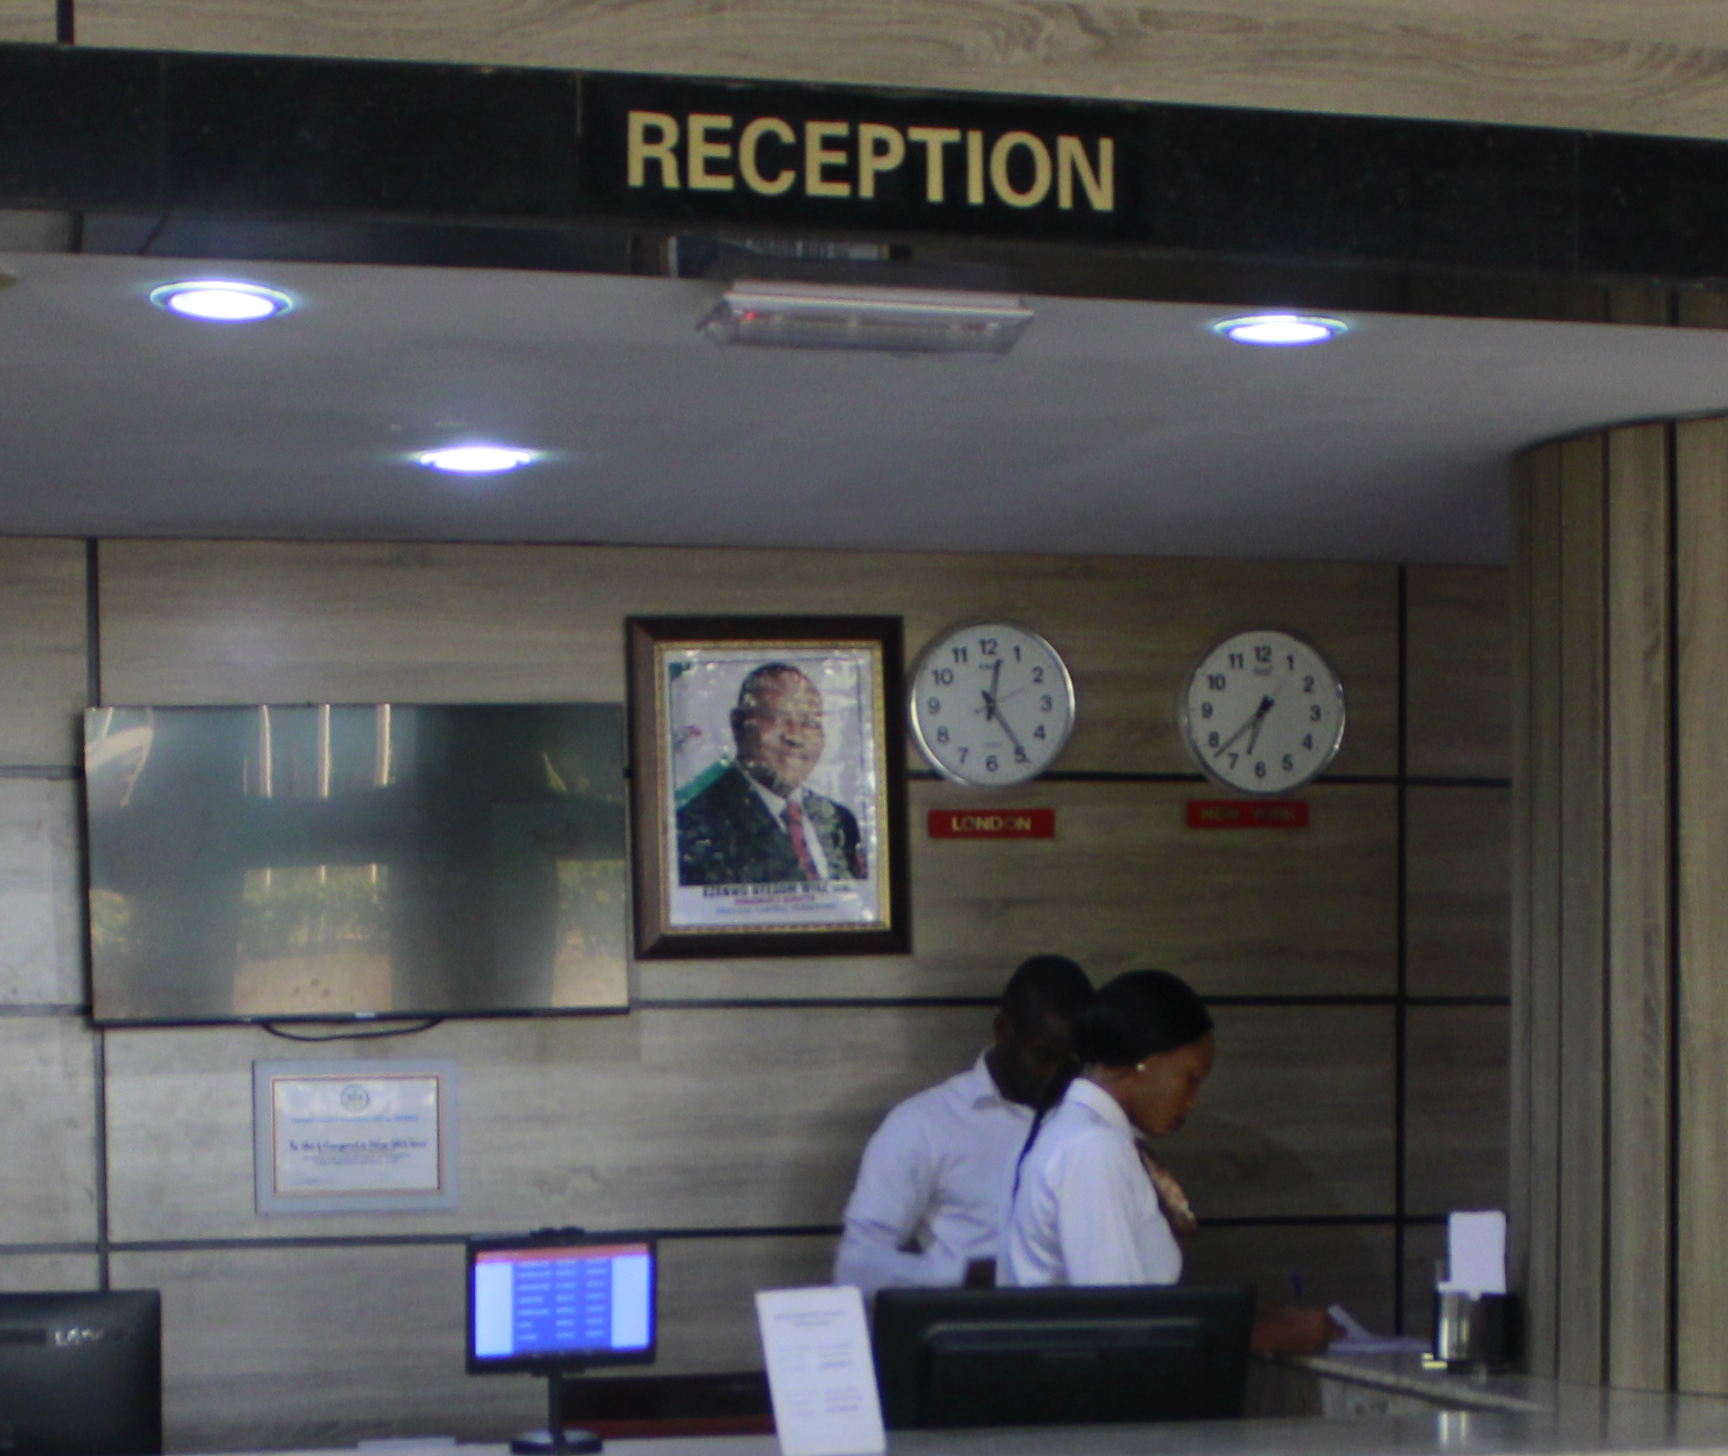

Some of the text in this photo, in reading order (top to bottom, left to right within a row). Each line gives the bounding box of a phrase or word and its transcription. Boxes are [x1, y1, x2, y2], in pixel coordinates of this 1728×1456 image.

[627, 110, 1115, 212] RECEPTION
[952, 646, 968, 663] 11
[979, 638, 998, 655] 12
[1013, 645, 1021, 661] 1
[1254, 645, 1272, 662] 12
[1229, 653, 1244, 669] 11
[1286, 654, 1294, 671] 1
[932, 668, 954, 685] 10
[1032, 666, 1044, 683] 2
[1207, 673, 1226, 690] 10
[1303, 675, 1315, 693] 2
[927, 697, 940, 714] 9
[1041, 694, 1052, 712] 3
[1202, 702, 1213, 719] 9
[1310, 704, 1321, 722] 3
[937, 726, 949, 744] 8
[1034, 724, 1046, 740] 4
[1208, 731, 1219, 748] 8
[1302, 733, 1313, 749] 4
[958, 747, 969, 763] 7
[986, 755, 998, 772] 6
[1228, 752, 1239, 769] 7
[1282, 753, 1293, 771] 5
[1254, 760, 1266, 778] 6
[952, 815, 1031, 832] LONDON
